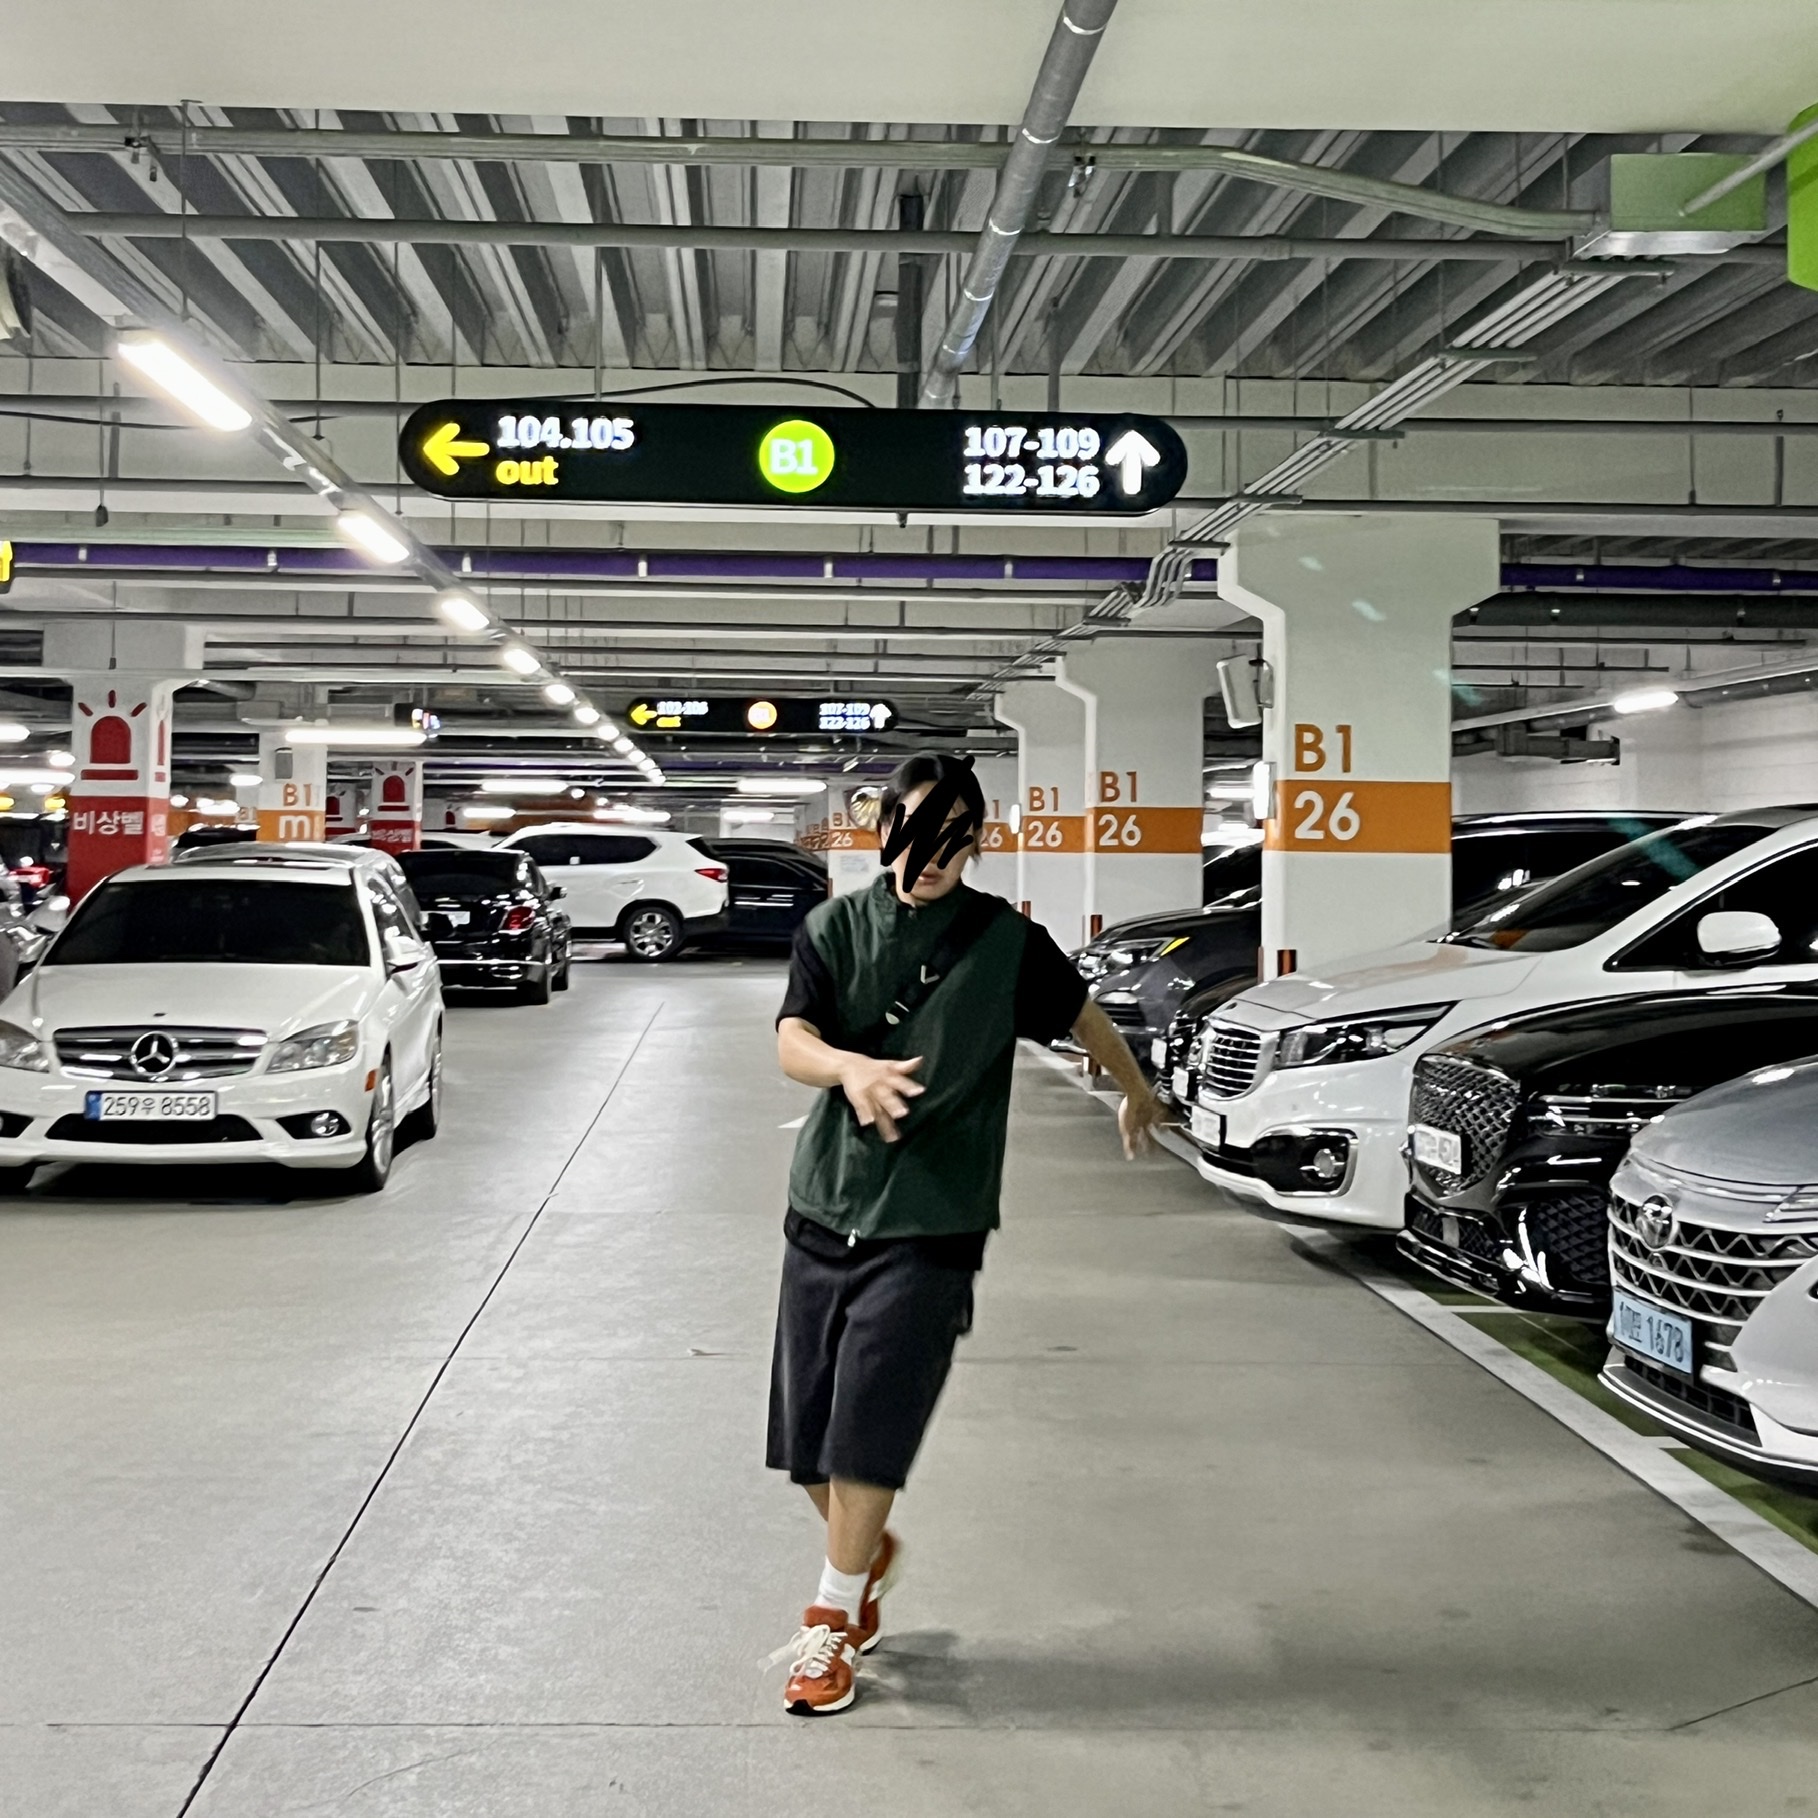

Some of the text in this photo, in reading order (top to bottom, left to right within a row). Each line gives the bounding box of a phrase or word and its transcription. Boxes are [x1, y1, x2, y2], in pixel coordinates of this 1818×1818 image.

[497, 415, 635, 450] 104.105
[963, 426, 1100, 460] 107-109
[496, 455, 559, 485] out
[770, 438, 818, 475] B1
[963, 463, 1100, 498] 122-126
[1295, 723, 1351, 773] B1
[283, 783, 311, 806] B1
[1029, 786, 1058, 812] B1
[1100, 771, 1137, 803] B1
[73, 810, 144, 835] 비상벨
[1098, 814, 1142, 847] 26
[1294, 790, 1360, 841] 26
[831, 832, 853, 848] 26
[1027, 821, 1063, 848] 26
[104, 1096, 211, 1116] 259우 8558
